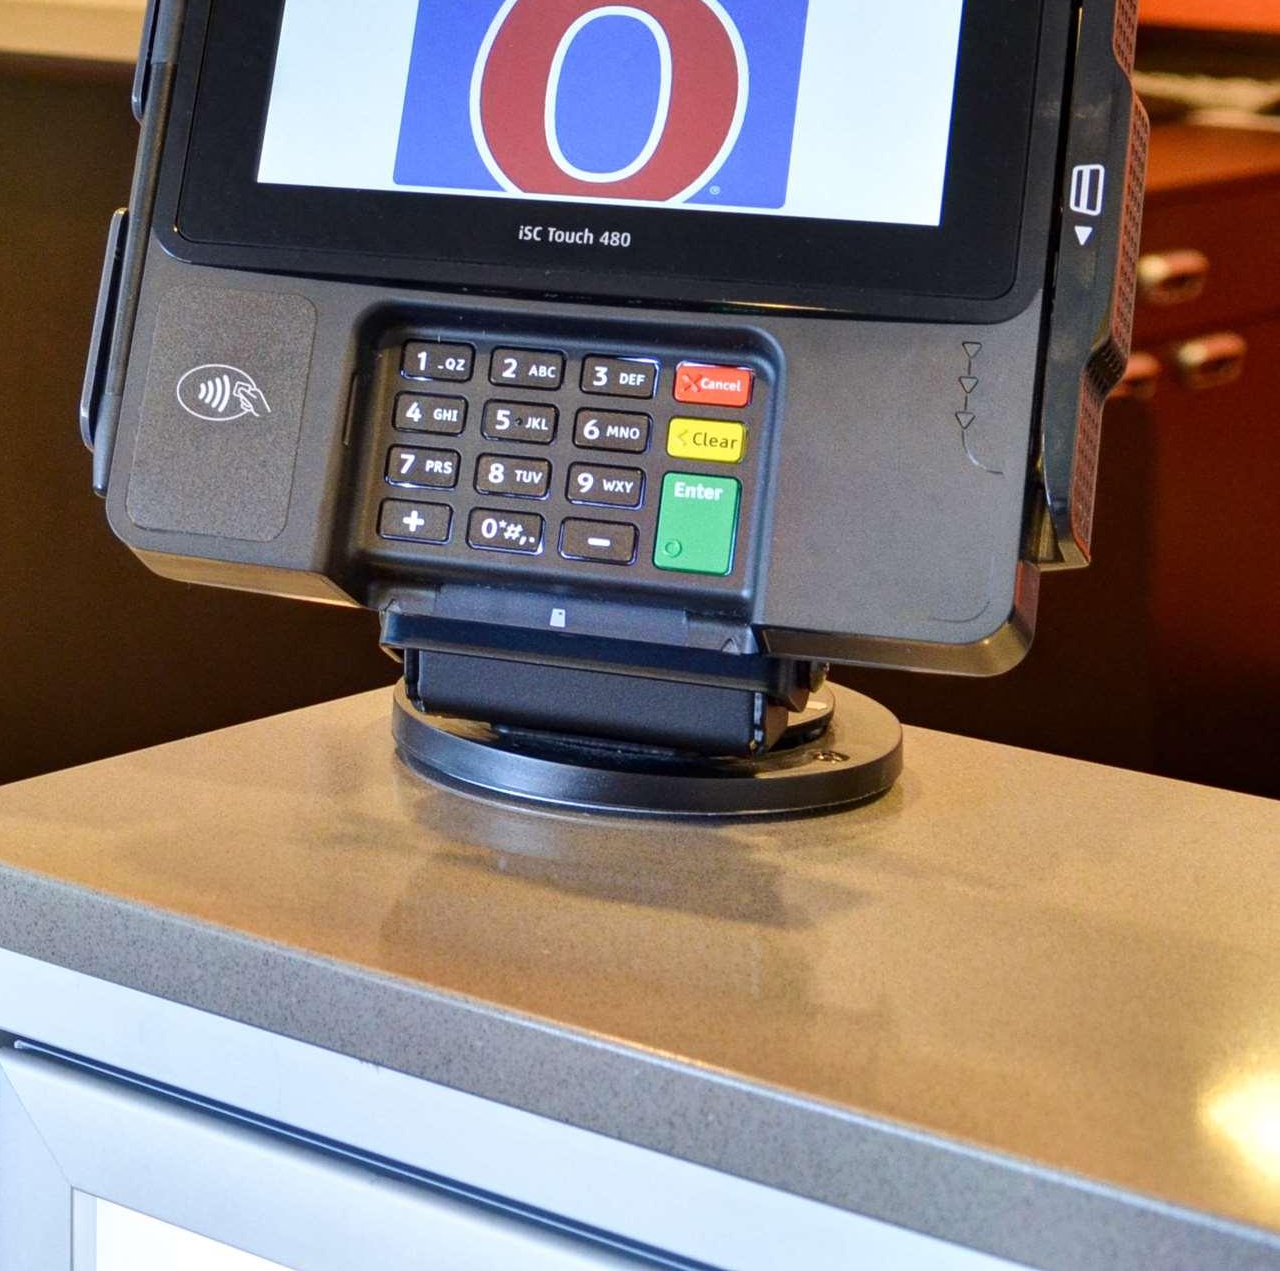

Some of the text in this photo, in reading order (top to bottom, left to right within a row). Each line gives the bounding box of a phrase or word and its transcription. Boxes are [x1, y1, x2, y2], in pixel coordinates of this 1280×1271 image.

[518, 225, 632, 248] iSC Touch 480
[417, 351, 427, 371] 1
[501, 358, 556, 379] 2 ABC
[592, 366, 645, 386] 3 DEF
[700, 377, 742, 393] Cancel
[405, 402, 458, 423] 4 GHI
[495, 409, 549, 431] 5 JKL
[583, 419, 640, 441] 6 MNO
[692, 431, 738, 451] Clear
[399, 453, 453, 475] 7 PRS
[488, 463, 543, 484] 8 TUV
[577, 473, 634, 494] 9 WXY
[673, 481, 724, 502] Enter
